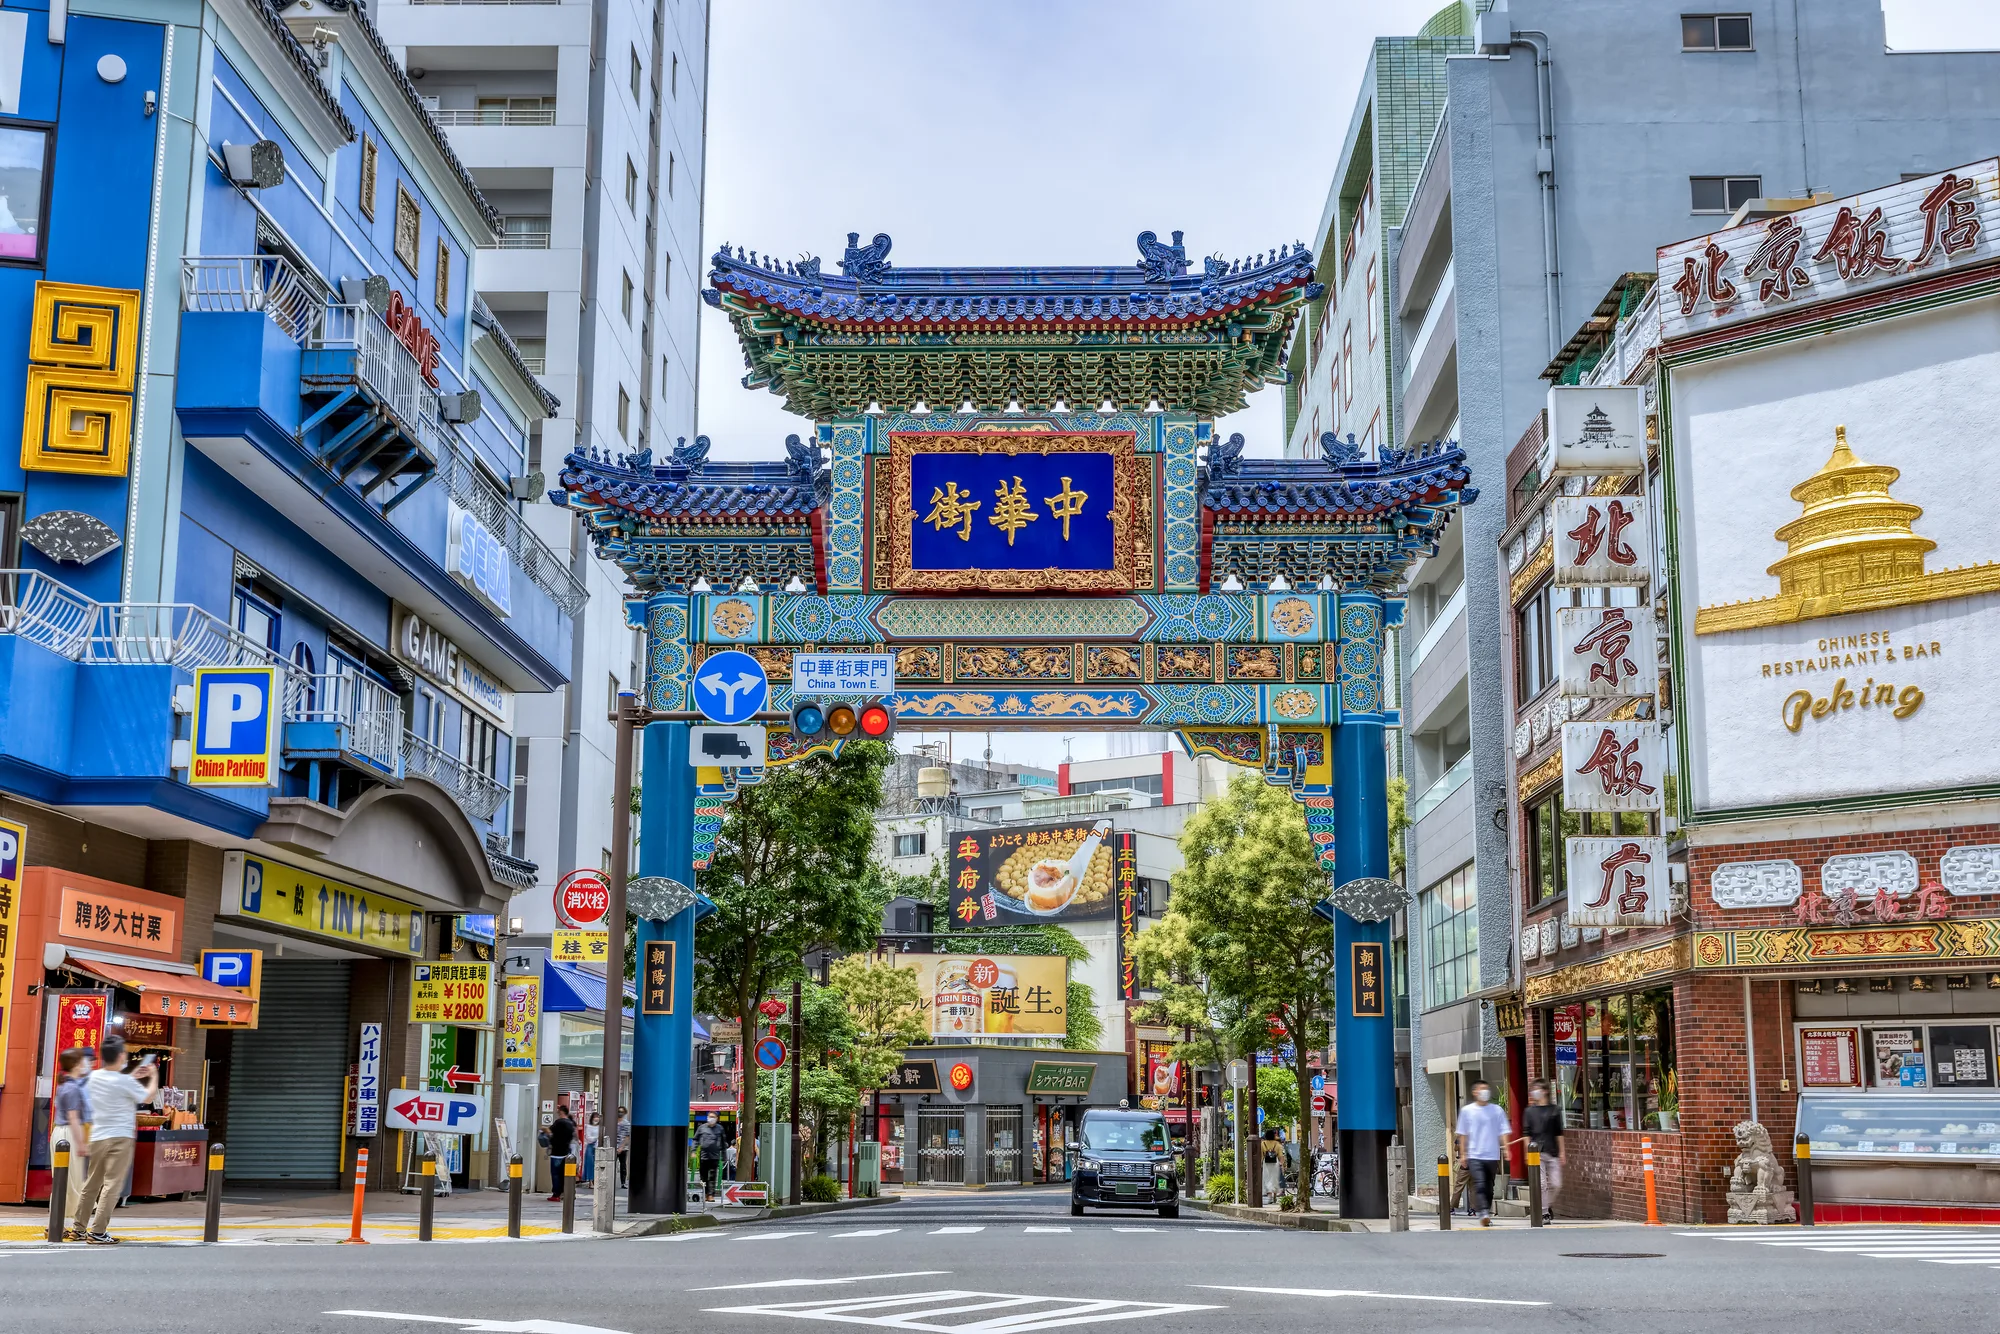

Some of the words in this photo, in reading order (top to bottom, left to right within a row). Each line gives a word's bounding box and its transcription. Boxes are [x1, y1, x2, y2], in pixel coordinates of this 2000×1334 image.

[1671, 173, 1984, 317] 北京飯店
[459, 509, 512, 617] SEGA
[403, 614, 457, 686] GAME
[1818, 630, 1890, 651] CHINESE
[800, 659, 888, 678] 中華街東門
[1762, 649, 1879, 677] RESTAURANT
[1886, 648, 1896, 661] &
[1903, 641, 1942, 659] BAR
[462, 661, 474, 694] by
[807, 679, 836, 689] China
[841, 679, 866, 689] Town
[870, 679, 880, 689] E.
[204, 683, 263, 749] P
[1782, 677, 1925, 733] Peking
[195, 759, 224, 777] China
[226, 759, 265, 779] Parking
[989, 833, 1022, 849] ようこそ
[957, 838, 981, 921] 王府井
[276, 883, 305, 917] 一般
[331, 889, 355, 935] IN
[567, 891, 606, 909] 消火栓
[75, 900, 162, 942] 聘珍大甘栗
[212, 956, 243, 983] P
[431, 966, 487, 980] 時間貸駐車場
[650, 947, 667, 1005] 朝陽門
[974, 963, 995, 984] 新
[1359, 949, 1377, 1008] 朝陽門
[443, 983, 485, 999] ¥1500
[528, 984, 537, 1017] チャイナで
[937, 994, 960, 1004] KIRIN
[961, 993, 981, 1004] BEER
[990, 985, 1063, 1015] 誕生。
[443, 1003, 484, 1020] ¥2800
[941, 1006, 975, 1016] 一番搾り
[360, 1025, 380, 1101] ハイルーフ車
[504, 1058, 534, 1068] SEGA
[1036, 1074, 1087, 1088] シウマイBAR
[359, 1106, 377, 1132] 空車
[406, 1102, 441, 1120] 入口
[447, 1100, 477, 1126] P
